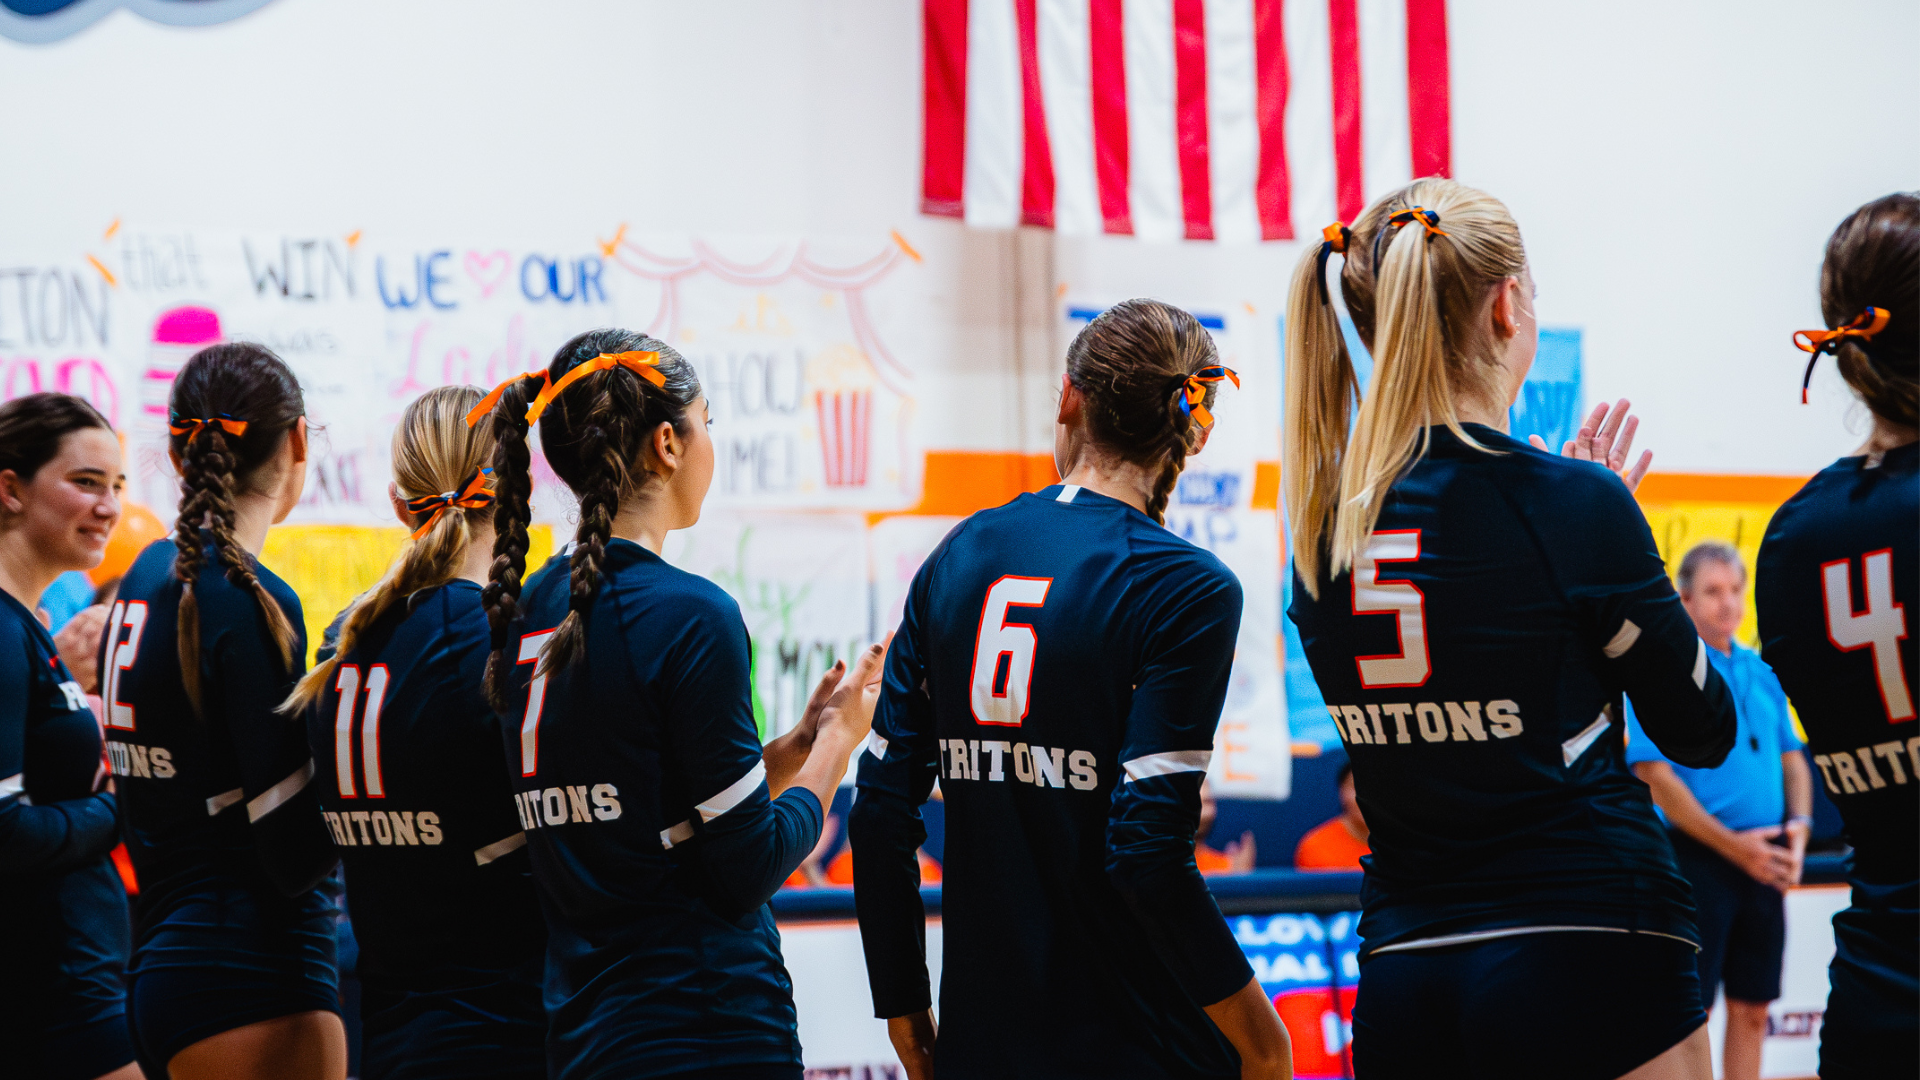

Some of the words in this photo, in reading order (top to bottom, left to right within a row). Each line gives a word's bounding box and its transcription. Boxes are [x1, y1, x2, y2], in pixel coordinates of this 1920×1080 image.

[0, 266, 112, 348] TON
[241, 235, 358, 302] WIN
[375, 249, 459, 311] WE
[519, 254, 611, 306] OUR
[689, 347, 806, 419] HOW
[716, 434, 797, 496] IME!
[969, 574, 1054, 727] 6
[1350, 528, 1432, 689] 5
[1820, 547, 1917, 725] 4
[102, 599, 149, 731] 12
[516, 626, 558, 777] 7
[335, 663, 390, 798] 11
[1326, 699, 1524, 744] TRITONS
